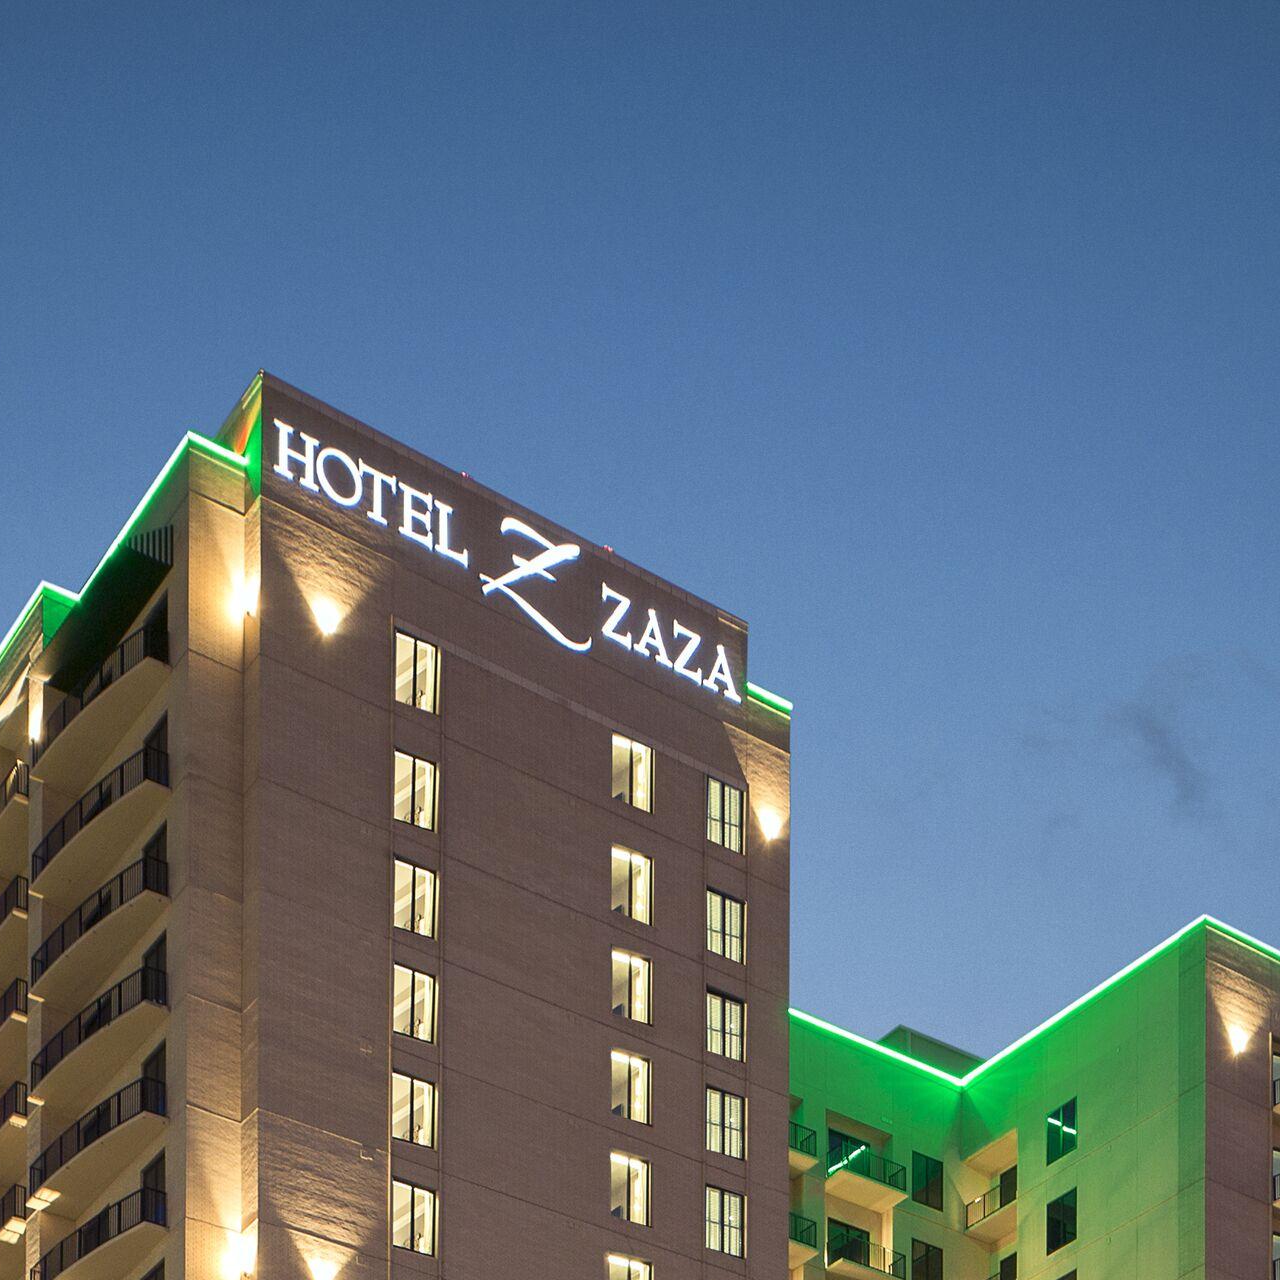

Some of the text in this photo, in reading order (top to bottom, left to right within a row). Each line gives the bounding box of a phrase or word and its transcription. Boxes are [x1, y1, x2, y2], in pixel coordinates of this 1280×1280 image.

[273, 418, 742, 704] HOTEL Z ZAZA
